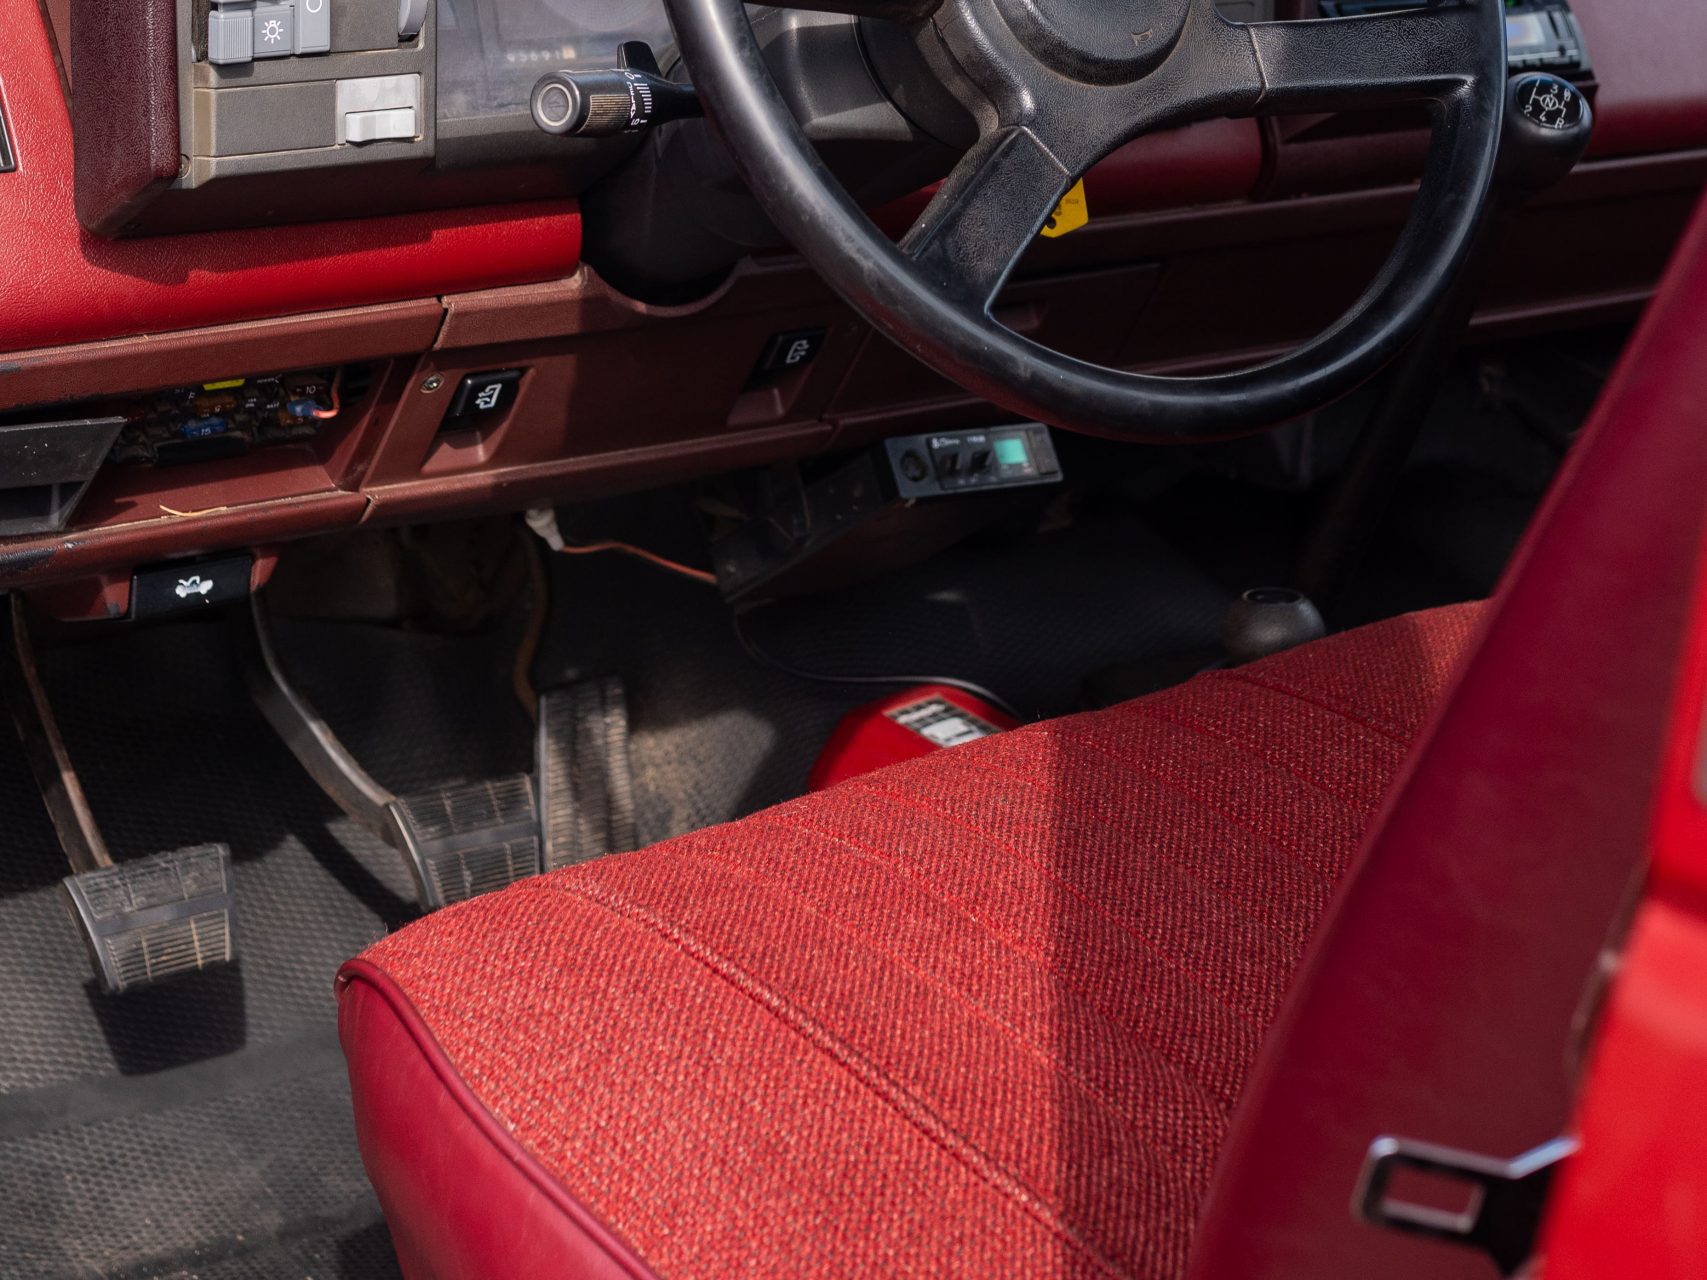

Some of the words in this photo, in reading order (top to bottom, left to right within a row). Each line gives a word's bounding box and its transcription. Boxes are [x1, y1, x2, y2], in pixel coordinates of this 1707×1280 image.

[1550, 83, 1559, 93] 3
[1523, 104, 1533, 117] 2
[1539, 110, 1547, 122] 4
[1554, 117, 1564, 128] R
